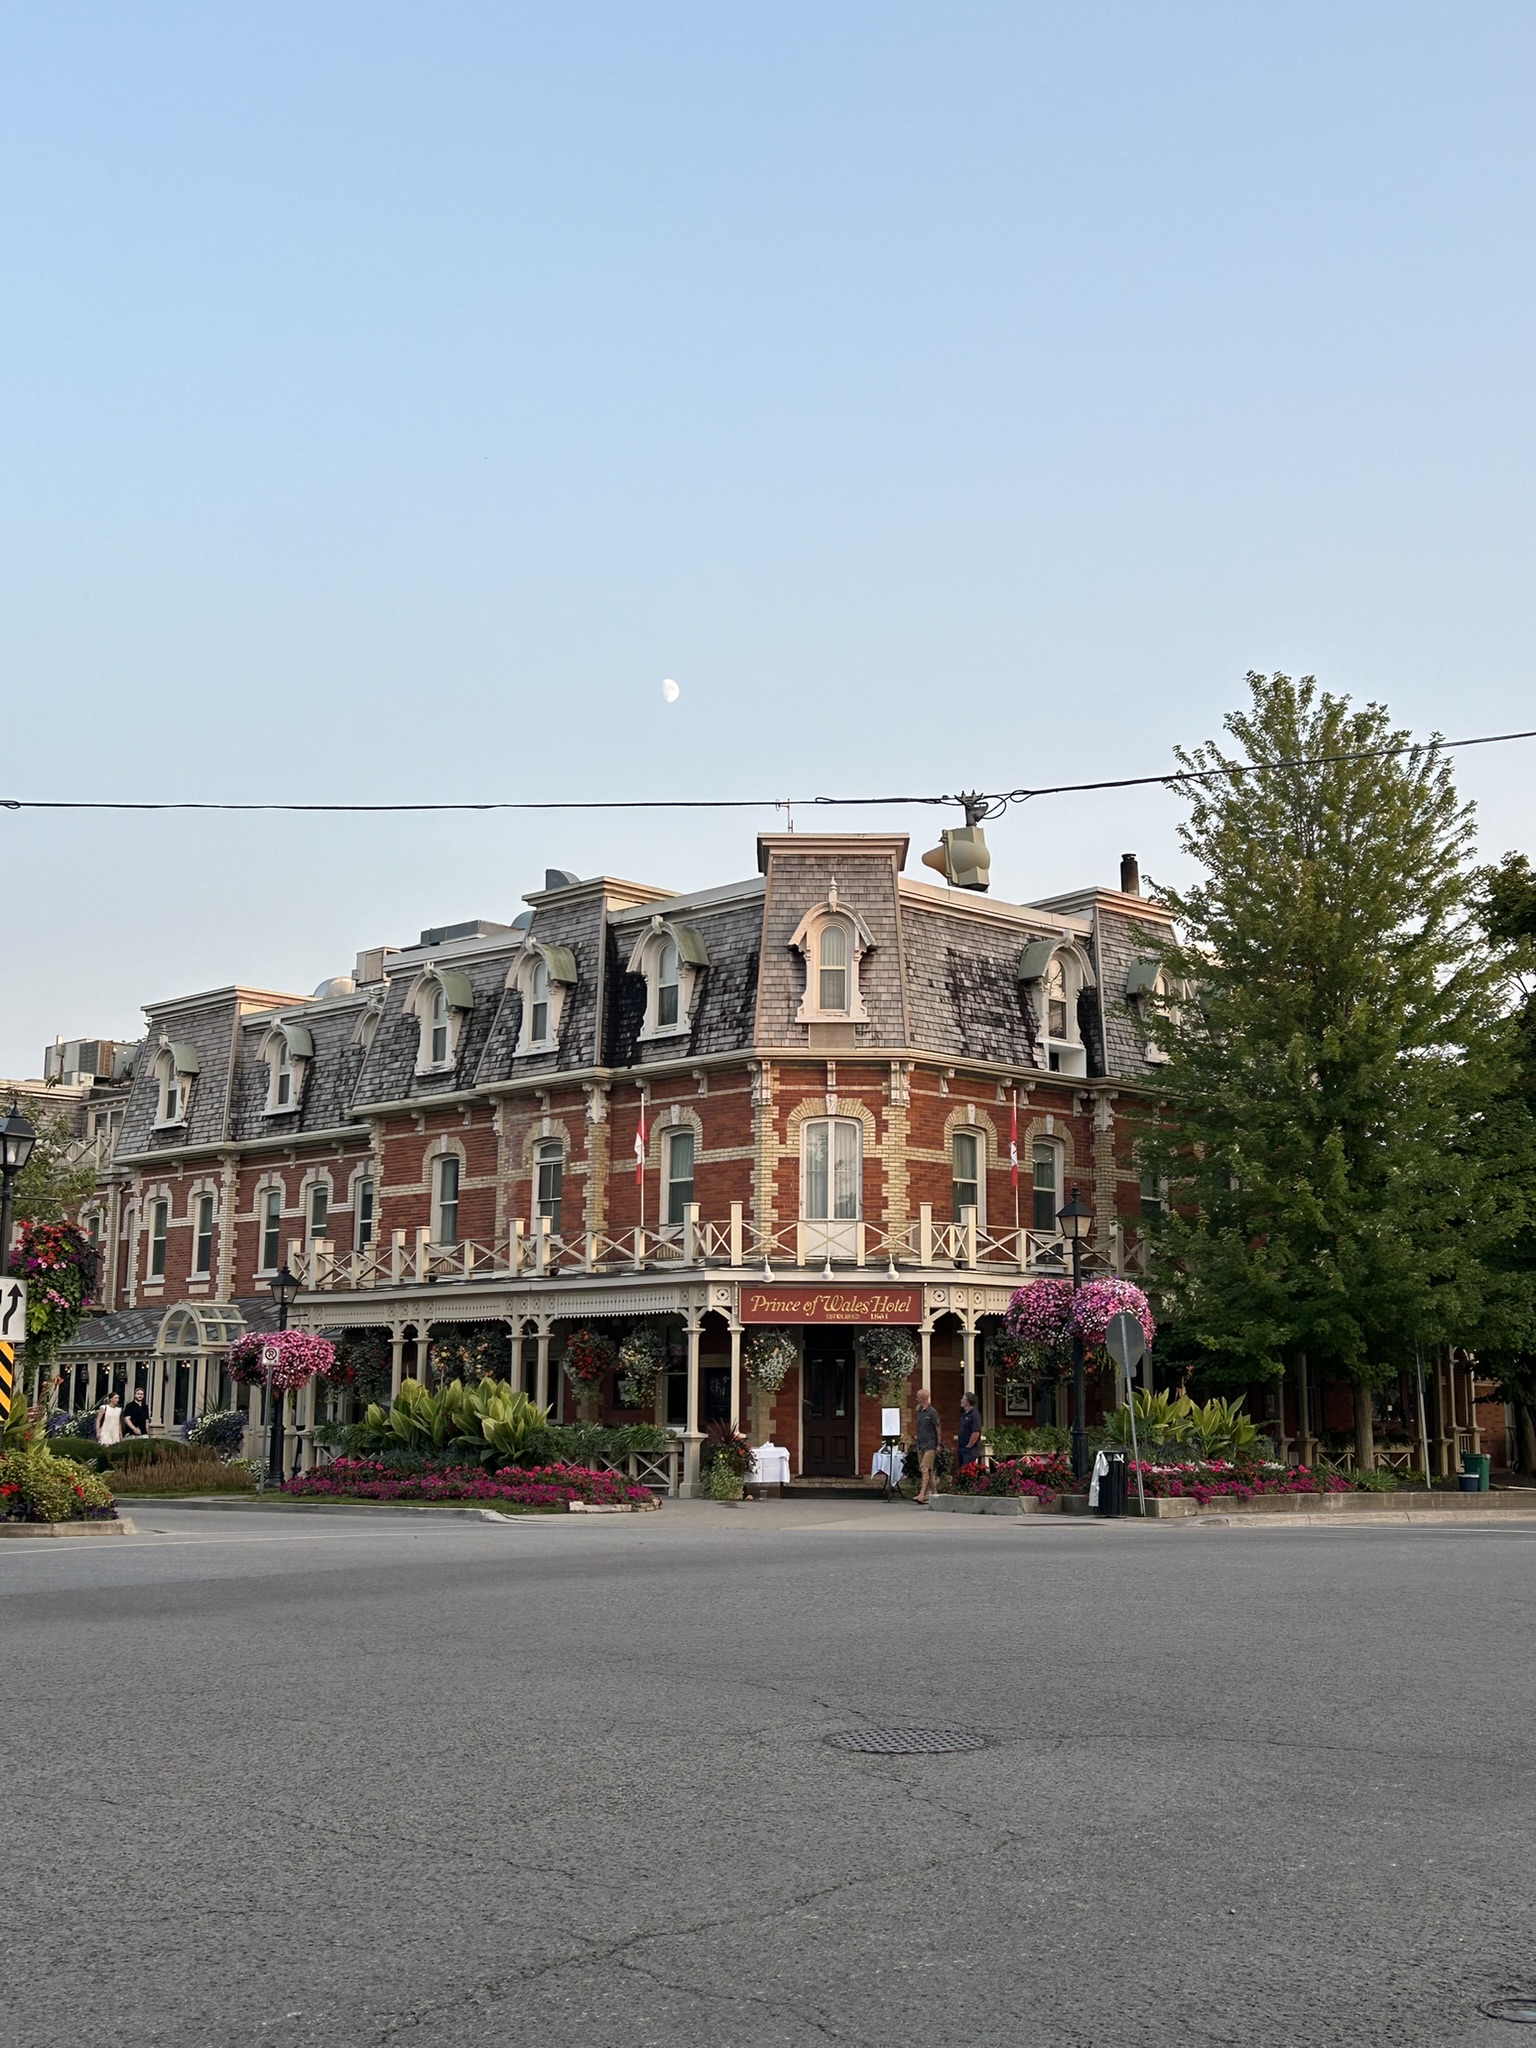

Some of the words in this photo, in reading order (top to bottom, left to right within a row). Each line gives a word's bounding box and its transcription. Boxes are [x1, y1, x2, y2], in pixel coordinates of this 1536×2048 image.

[750, 1295, 801, 1312] Prince
[803, 1295, 823, 1316] of
[821, 1294, 870, 1314] Wales
[870, 1295, 912, 1312] Hotel
